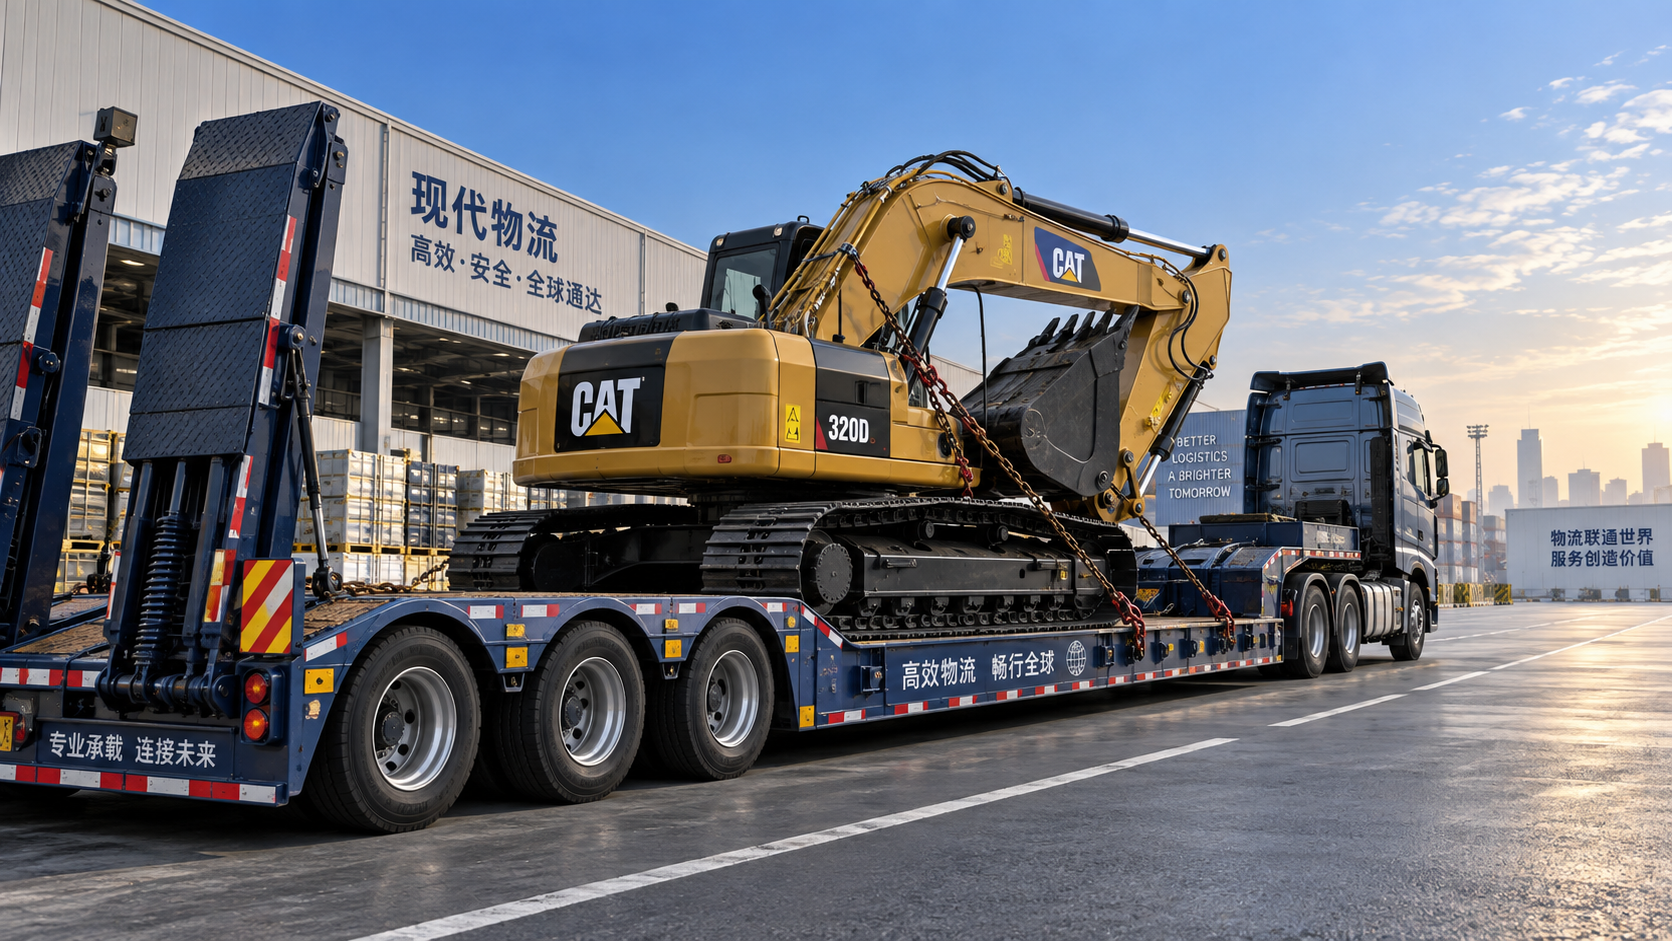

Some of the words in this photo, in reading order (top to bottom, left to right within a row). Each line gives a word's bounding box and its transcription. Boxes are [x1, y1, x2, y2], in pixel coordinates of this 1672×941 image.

[411, 171, 558, 263] 现代物流
[1053, 247, 1085, 283] CAT
[571, 377, 641, 437] CAT
[828, 414, 869, 443] 320D
[1177, 434, 1216, 447] BETTER
[1172, 450, 1228, 464] LOGISTICS
[1168, 471, 1176, 482] A
[1179, 468, 1231, 481] BRIGHTER
[1169, 486, 1231, 499] TOMORROW
[1550, 528, 1653, 547] 物流联通世界
[1551, 549, 1654, 568] 服务创造价值
[902, 656, 976, 691] 高效物流
[991, 650, 1055, 681] 畅行全球
[49, 730, 124, 762] 专业承载
[135, 736, 216, 768] 连接未来
